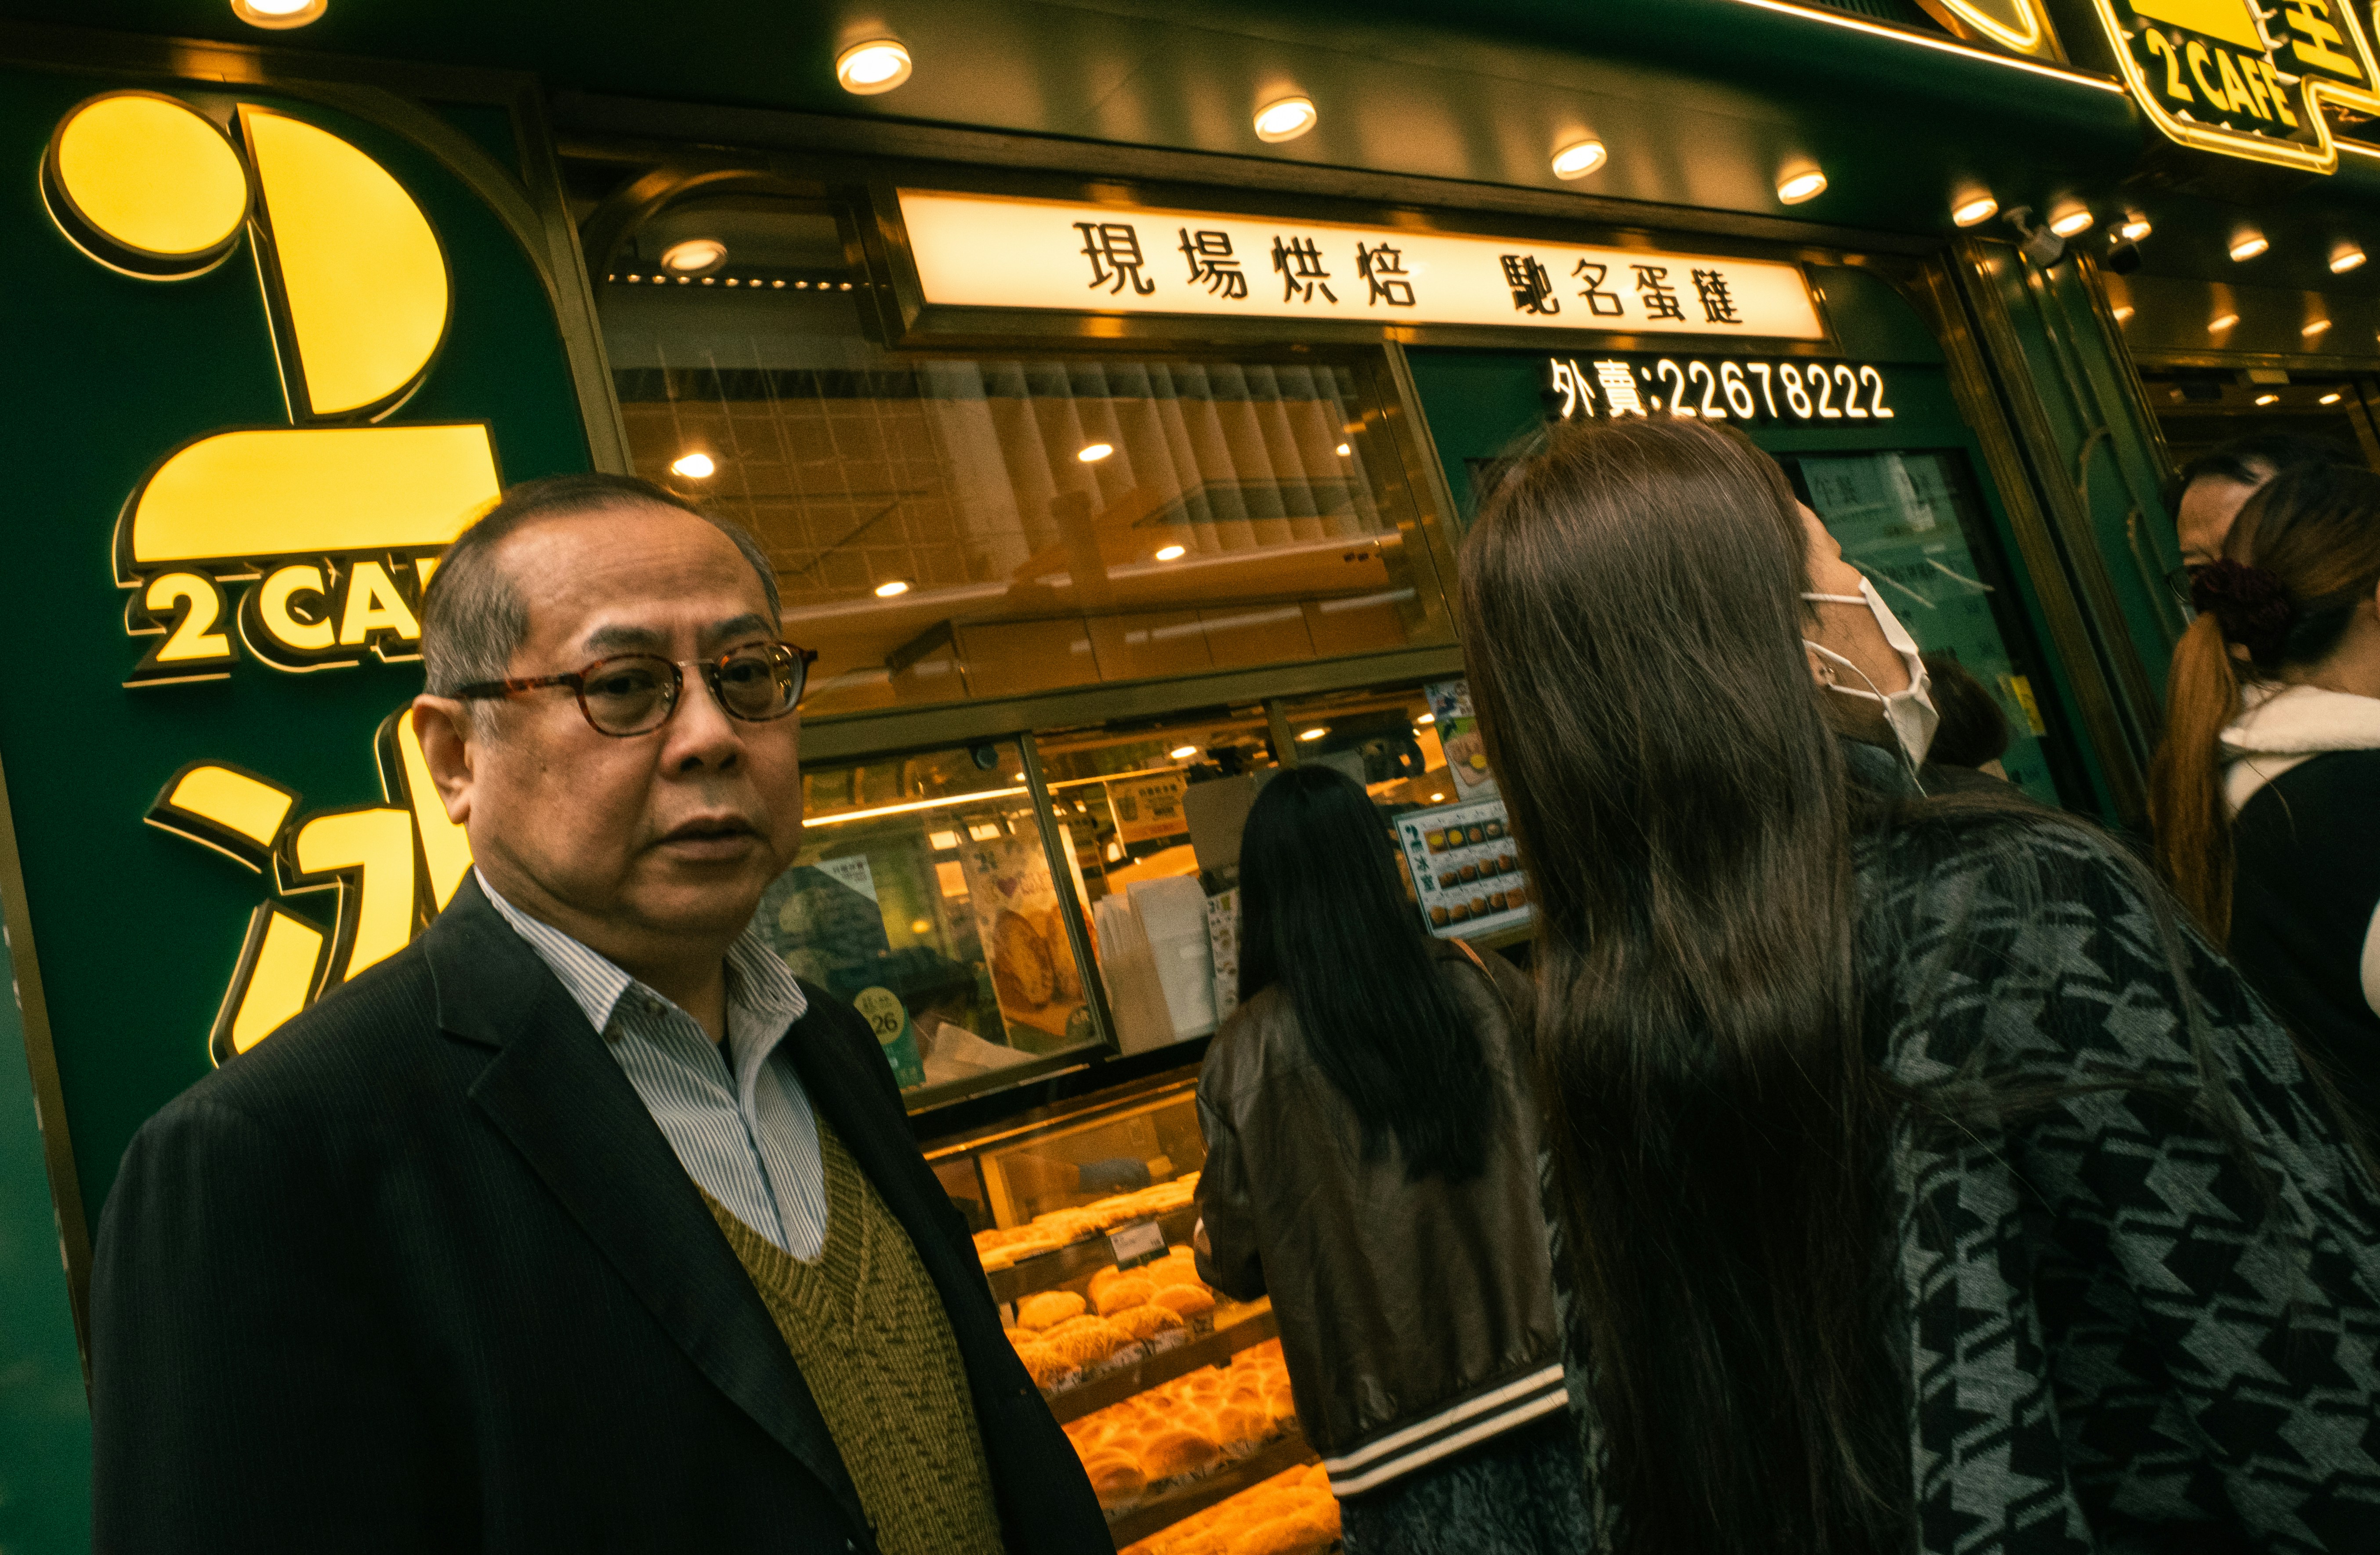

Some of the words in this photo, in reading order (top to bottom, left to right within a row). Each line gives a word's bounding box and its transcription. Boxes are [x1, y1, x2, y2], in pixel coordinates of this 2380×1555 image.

[2146, 28, 2194, 102] 2
[2187, 41, 2299, 127] CAFE
[1073, 221, 1416, 307] 現場烘焙
[1500, 254, 1743, 324] 馳名蛋撻
[145, 572, 230, 662] 2
[260, 557, 440, 650] CA
[872, 1011, 898, 1034] 26
